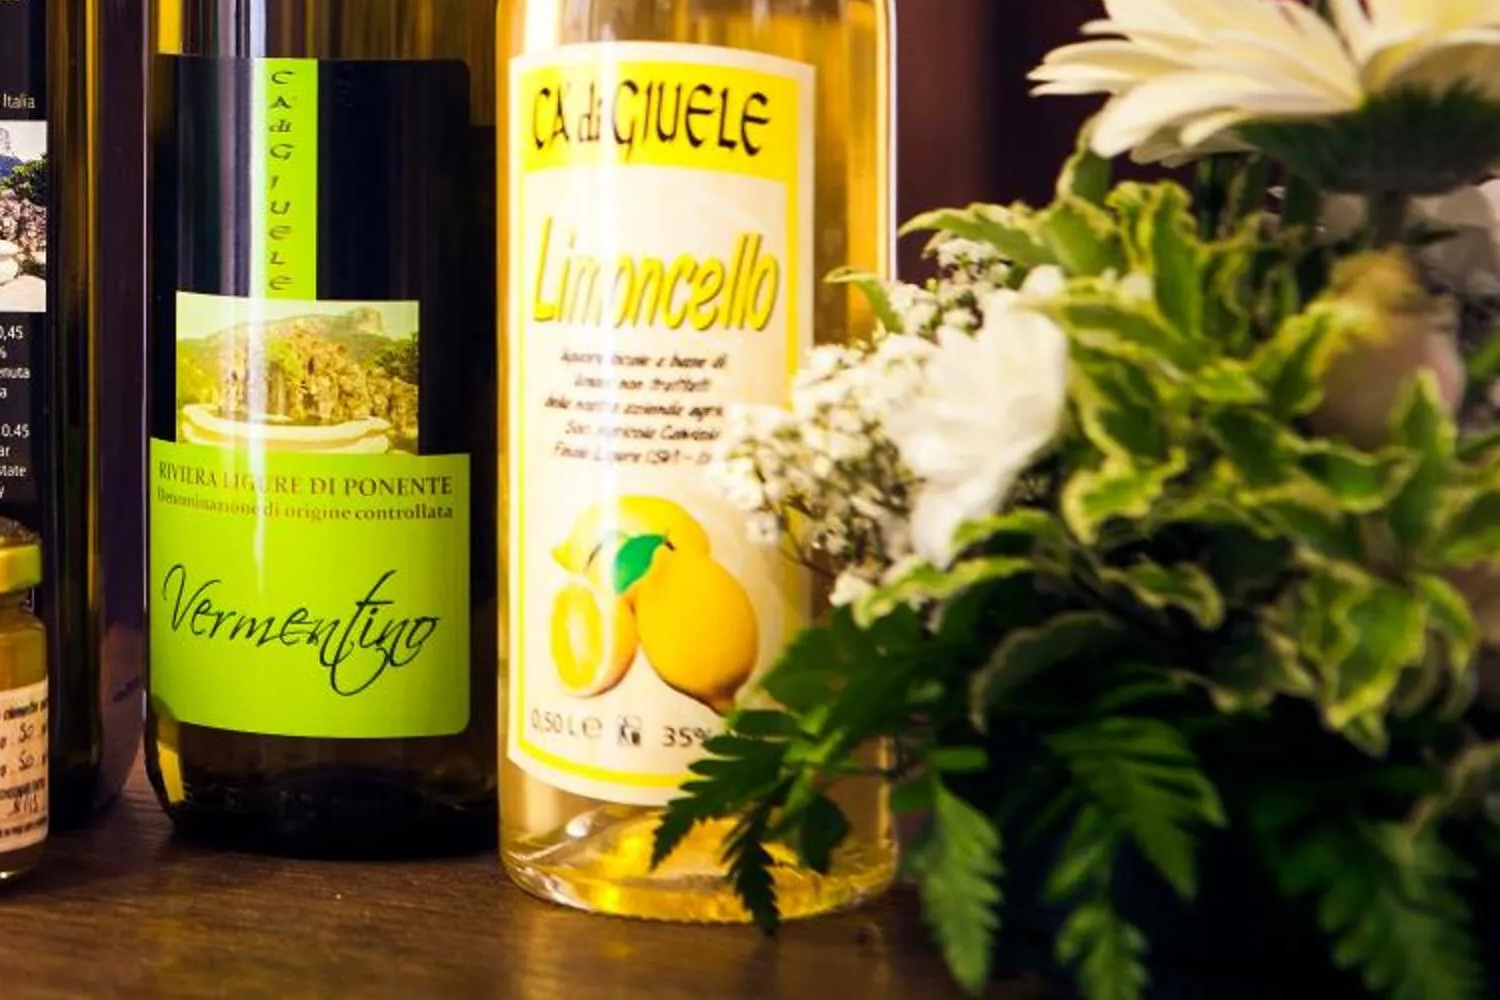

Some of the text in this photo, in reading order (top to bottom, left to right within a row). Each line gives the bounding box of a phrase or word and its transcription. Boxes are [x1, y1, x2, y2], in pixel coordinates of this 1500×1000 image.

[2, 93, 36, 110] Italia
[577, 81, 604, 143] di
[612, 79, 771, 163] GIUELE
[532, 214, 780, 332] Limoncello
[157, 486, 259, 518] Denominazione
[286, 502, 352, 523] origine
[354, 501, 454, 521] controllata
[158, 460, 218, 487] RIVIERA
[310, 475, 336, 496] DI
[343, 475, 453, 498] PONENTE
[162, 562, 441, 697] Vermentino
